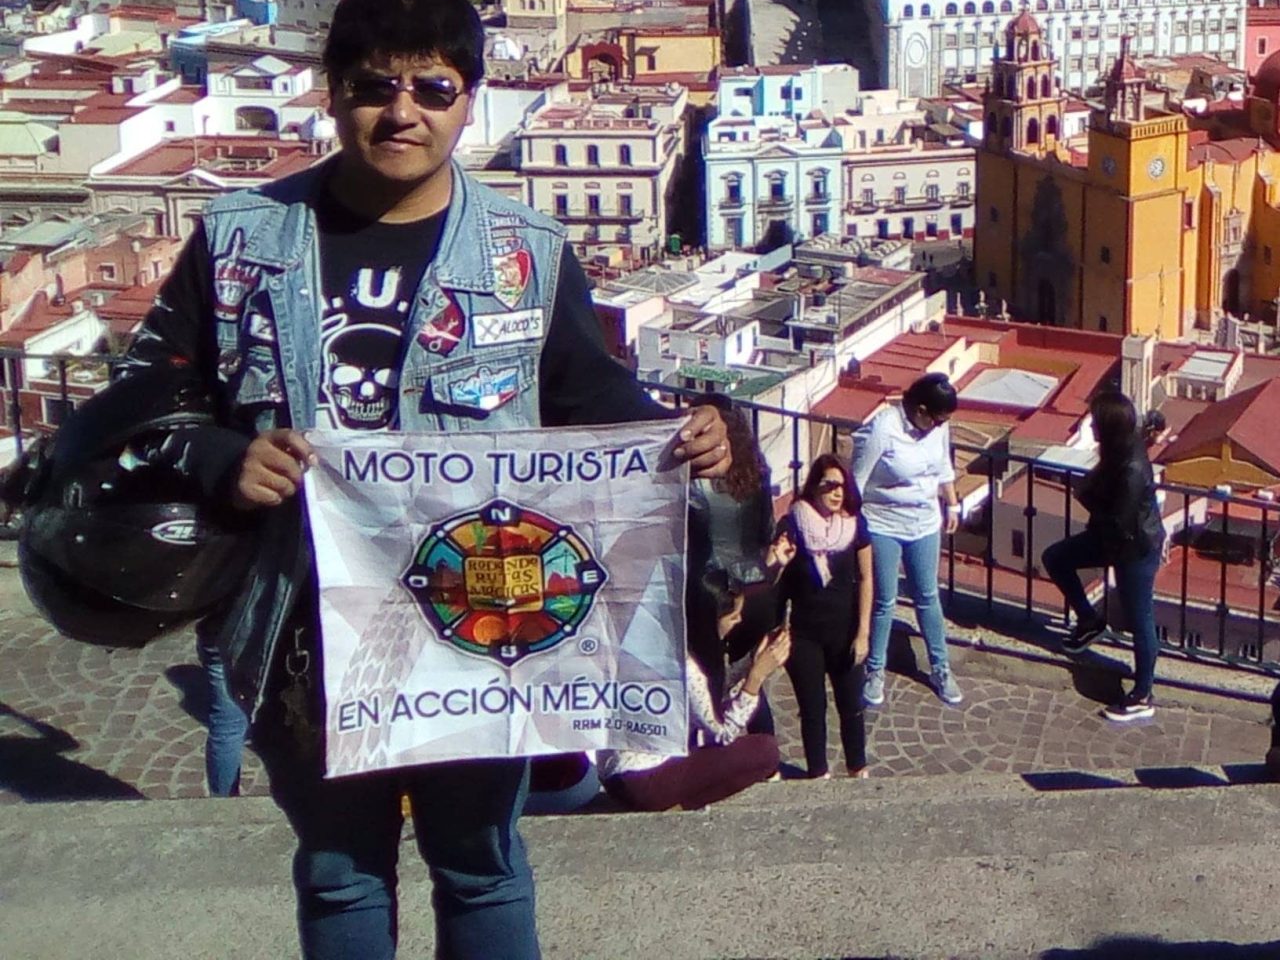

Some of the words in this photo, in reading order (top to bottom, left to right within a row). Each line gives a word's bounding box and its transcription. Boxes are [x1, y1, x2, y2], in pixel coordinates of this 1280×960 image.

[344, 449, 474, 484] MOTO
[486, 448, 648, 484] TURISTA
[338, 695, 379, 731] EN
[391, 678, 532, 723] ACCIÓN
[542, 676, 672, 716] MÉXICO
